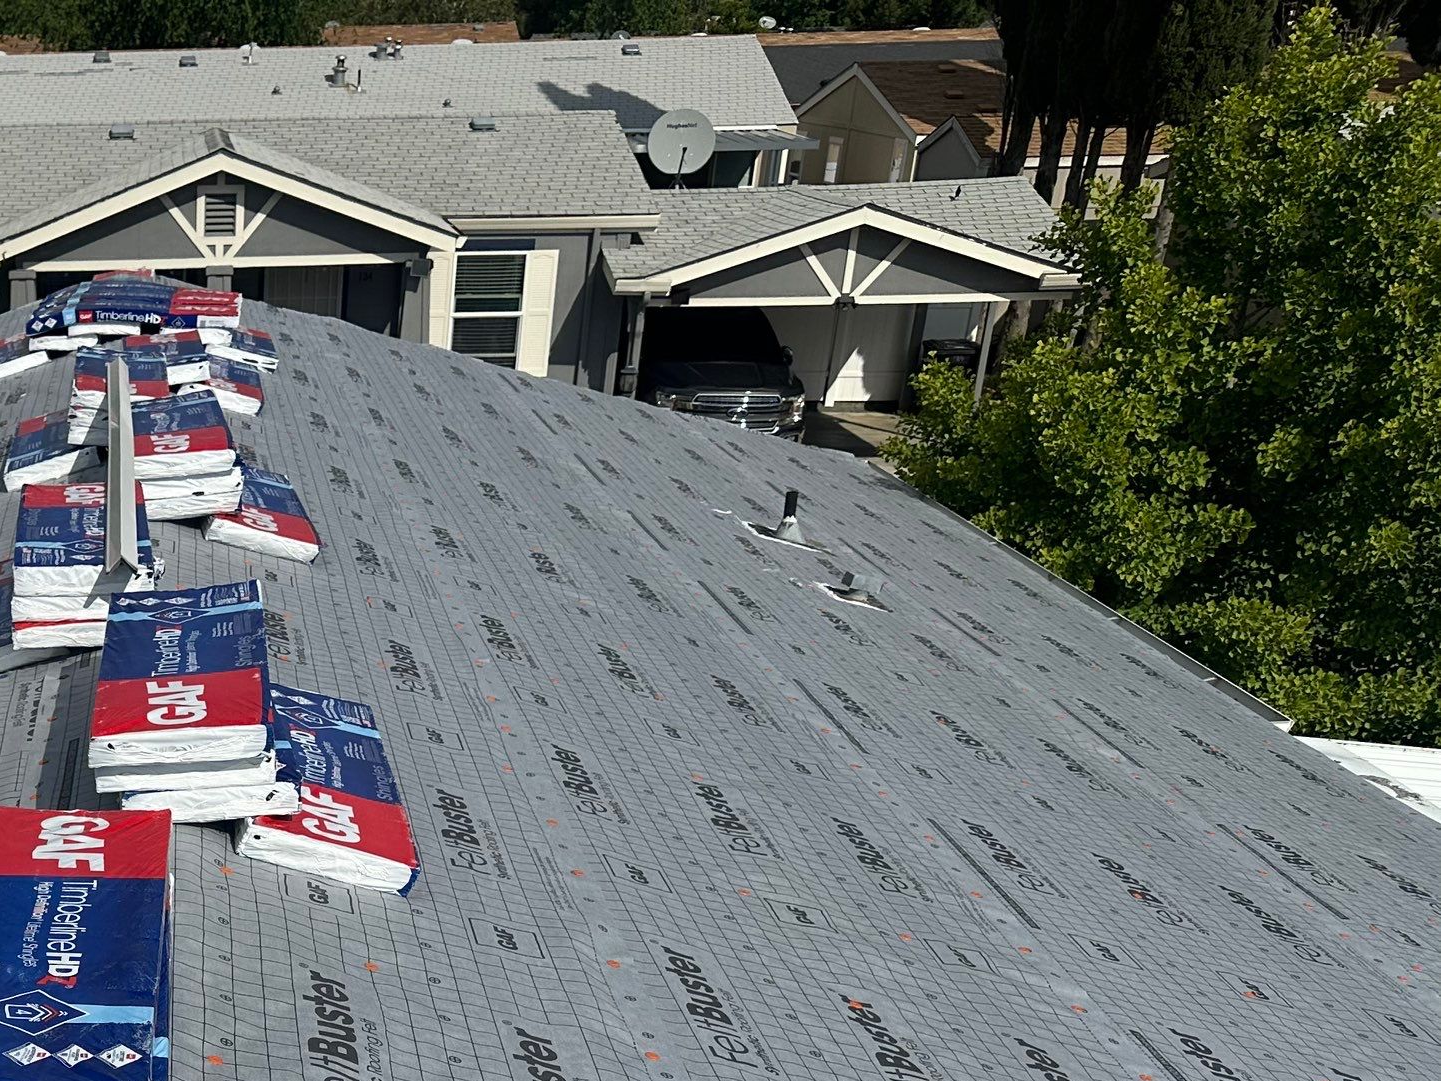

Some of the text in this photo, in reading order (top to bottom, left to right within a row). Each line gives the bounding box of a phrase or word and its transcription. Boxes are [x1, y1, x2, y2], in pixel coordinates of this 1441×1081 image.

[95, 310, 166, 327] TimberlineHDZ
[150, 434, 190, 461] GAF
[240, 507, 279, 532] GAF
[146, 681, 208, 725] GAF
[301, 786, 361, 843] GAF
[31, 815, 110, 872] GAF
[432, 789, 491, 876] FeltBuster
[625, 863, 650, 885] GAF
[307, 879, 330, 906] GAF
[786, 905, 815, 926] GAF
[36, 880, 97, 988] TimberlineHDZ
[494, 926, 519, 953] GAF
[664, 945, 759, 1069] FeltBuster
